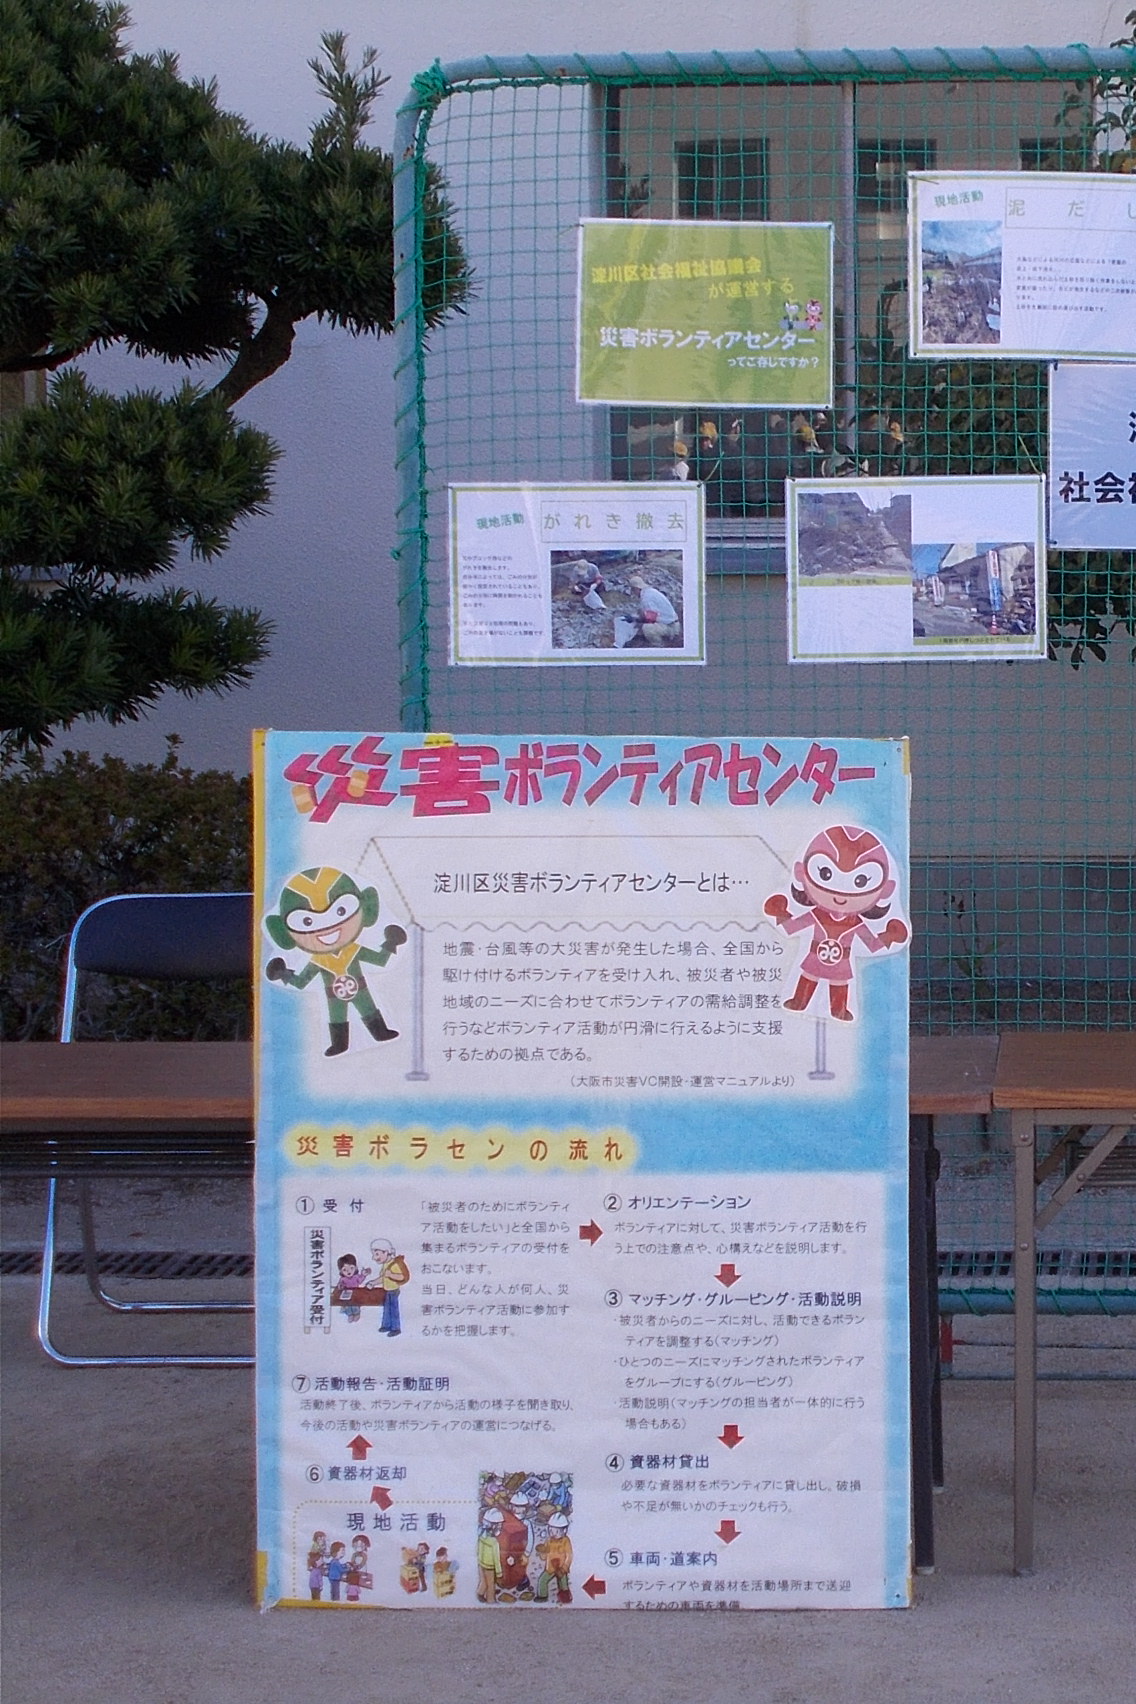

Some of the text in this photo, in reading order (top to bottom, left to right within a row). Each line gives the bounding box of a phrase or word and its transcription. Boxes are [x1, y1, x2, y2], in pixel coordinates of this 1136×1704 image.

[708, 278, 794, 299] が運営する
[600, 327, 815, 349] 災害ボランティアセンター
[543, 512, 685, 530] がれき撤去
[283, 735, 877, 823] 災害ボランティアセンター
[433, 871, 750, 894] 淀川区災害ボランティアセンターとは…
[442, 940, 785, 958] 地震・台風等の大災害が発生した場合、全国から
[442, 966, 783, 983] 駆け付けるボランティアを受け入れ、被災者や被災
[442, 993, 783, 1010] 地域のニーズに合わせてボランティアの需給調整を
[442, 1019, 784, 1037] 行うなどボランティア活動が円滑に行えるように支援
[442, 1045, 593, 1063] するための拠点である。
[296, 1133, 624, 1162] 災害ボラセンの流れ
[322, 1196, 366, 1215] 受付
[420, 1199, 571, 1214] 「被災者のためにボランティ
[627, 1195, 752, 1211] オリエンテーション
[420, 1219, 572, 1235] ア活動をしたい」と全国から
[614, 1220, 868, 1235] ボランティアに対して、災害ボランティア活動を行
[420, 1240, 571, 1256] 集まるボランティアの受付を
[614, 1241, 848, 1257] う上での注意点や、心構えなどを説明します。
[309, 1228, 326, 1326] 災害ボランティア受付
[420, 1262, 493, 1276] おこないます。
[420, 1283, 570, 1297] 当日、どんな人が何人、災
[420, 1303, 571, 1317] 害ボランティア活動に参加す
[420, 1323, 516, 1338] るかを把握します。
[314, 1376, 450, 1392] 活動報告・活動証明
[300, 1398, 576, 1412] 活動終了後、ボランティアから活動の様子を聞き取り、
[300, 1419, 558, 1433] 今後の活動や災害ボランティアの運営につなげる。
[629, 1455, 710, 1470] 資器材貸出
[327, 1466, 408, 1481] 資器材返却
[620, 1499, 795, 1514] や不足が無いかのチェックも行う。
[346, 1512, 447, 1532] 現地活動
[622, 1579, 852, 1593] ボランティアや資器材を活動場所まで送迎
